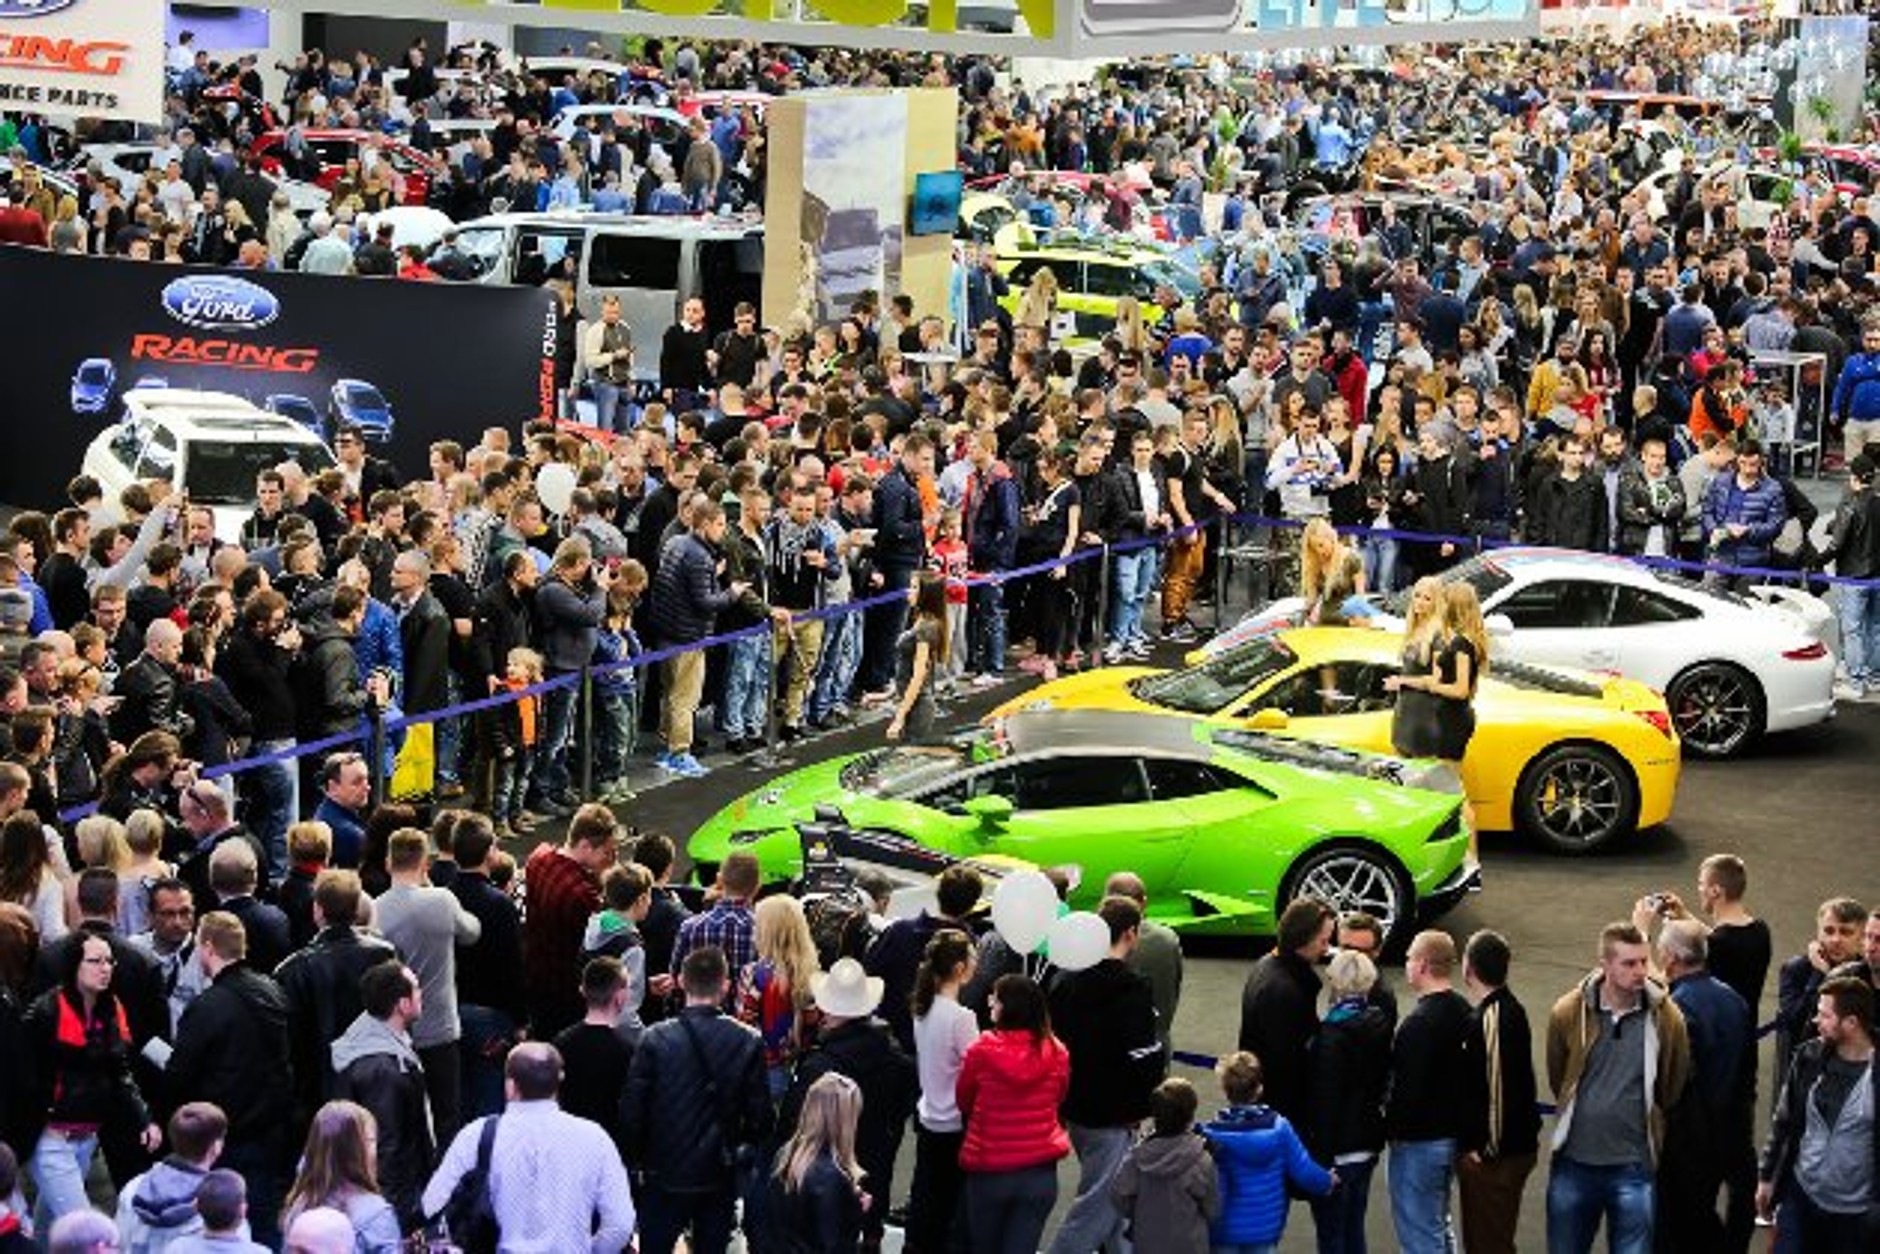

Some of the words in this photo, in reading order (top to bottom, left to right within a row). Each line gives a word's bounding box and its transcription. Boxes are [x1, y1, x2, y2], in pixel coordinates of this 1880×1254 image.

[48, 87, 118, 109] PARTS
[182, 286, 256, 322] Ford
[132, 334, 318, 372] RACING
